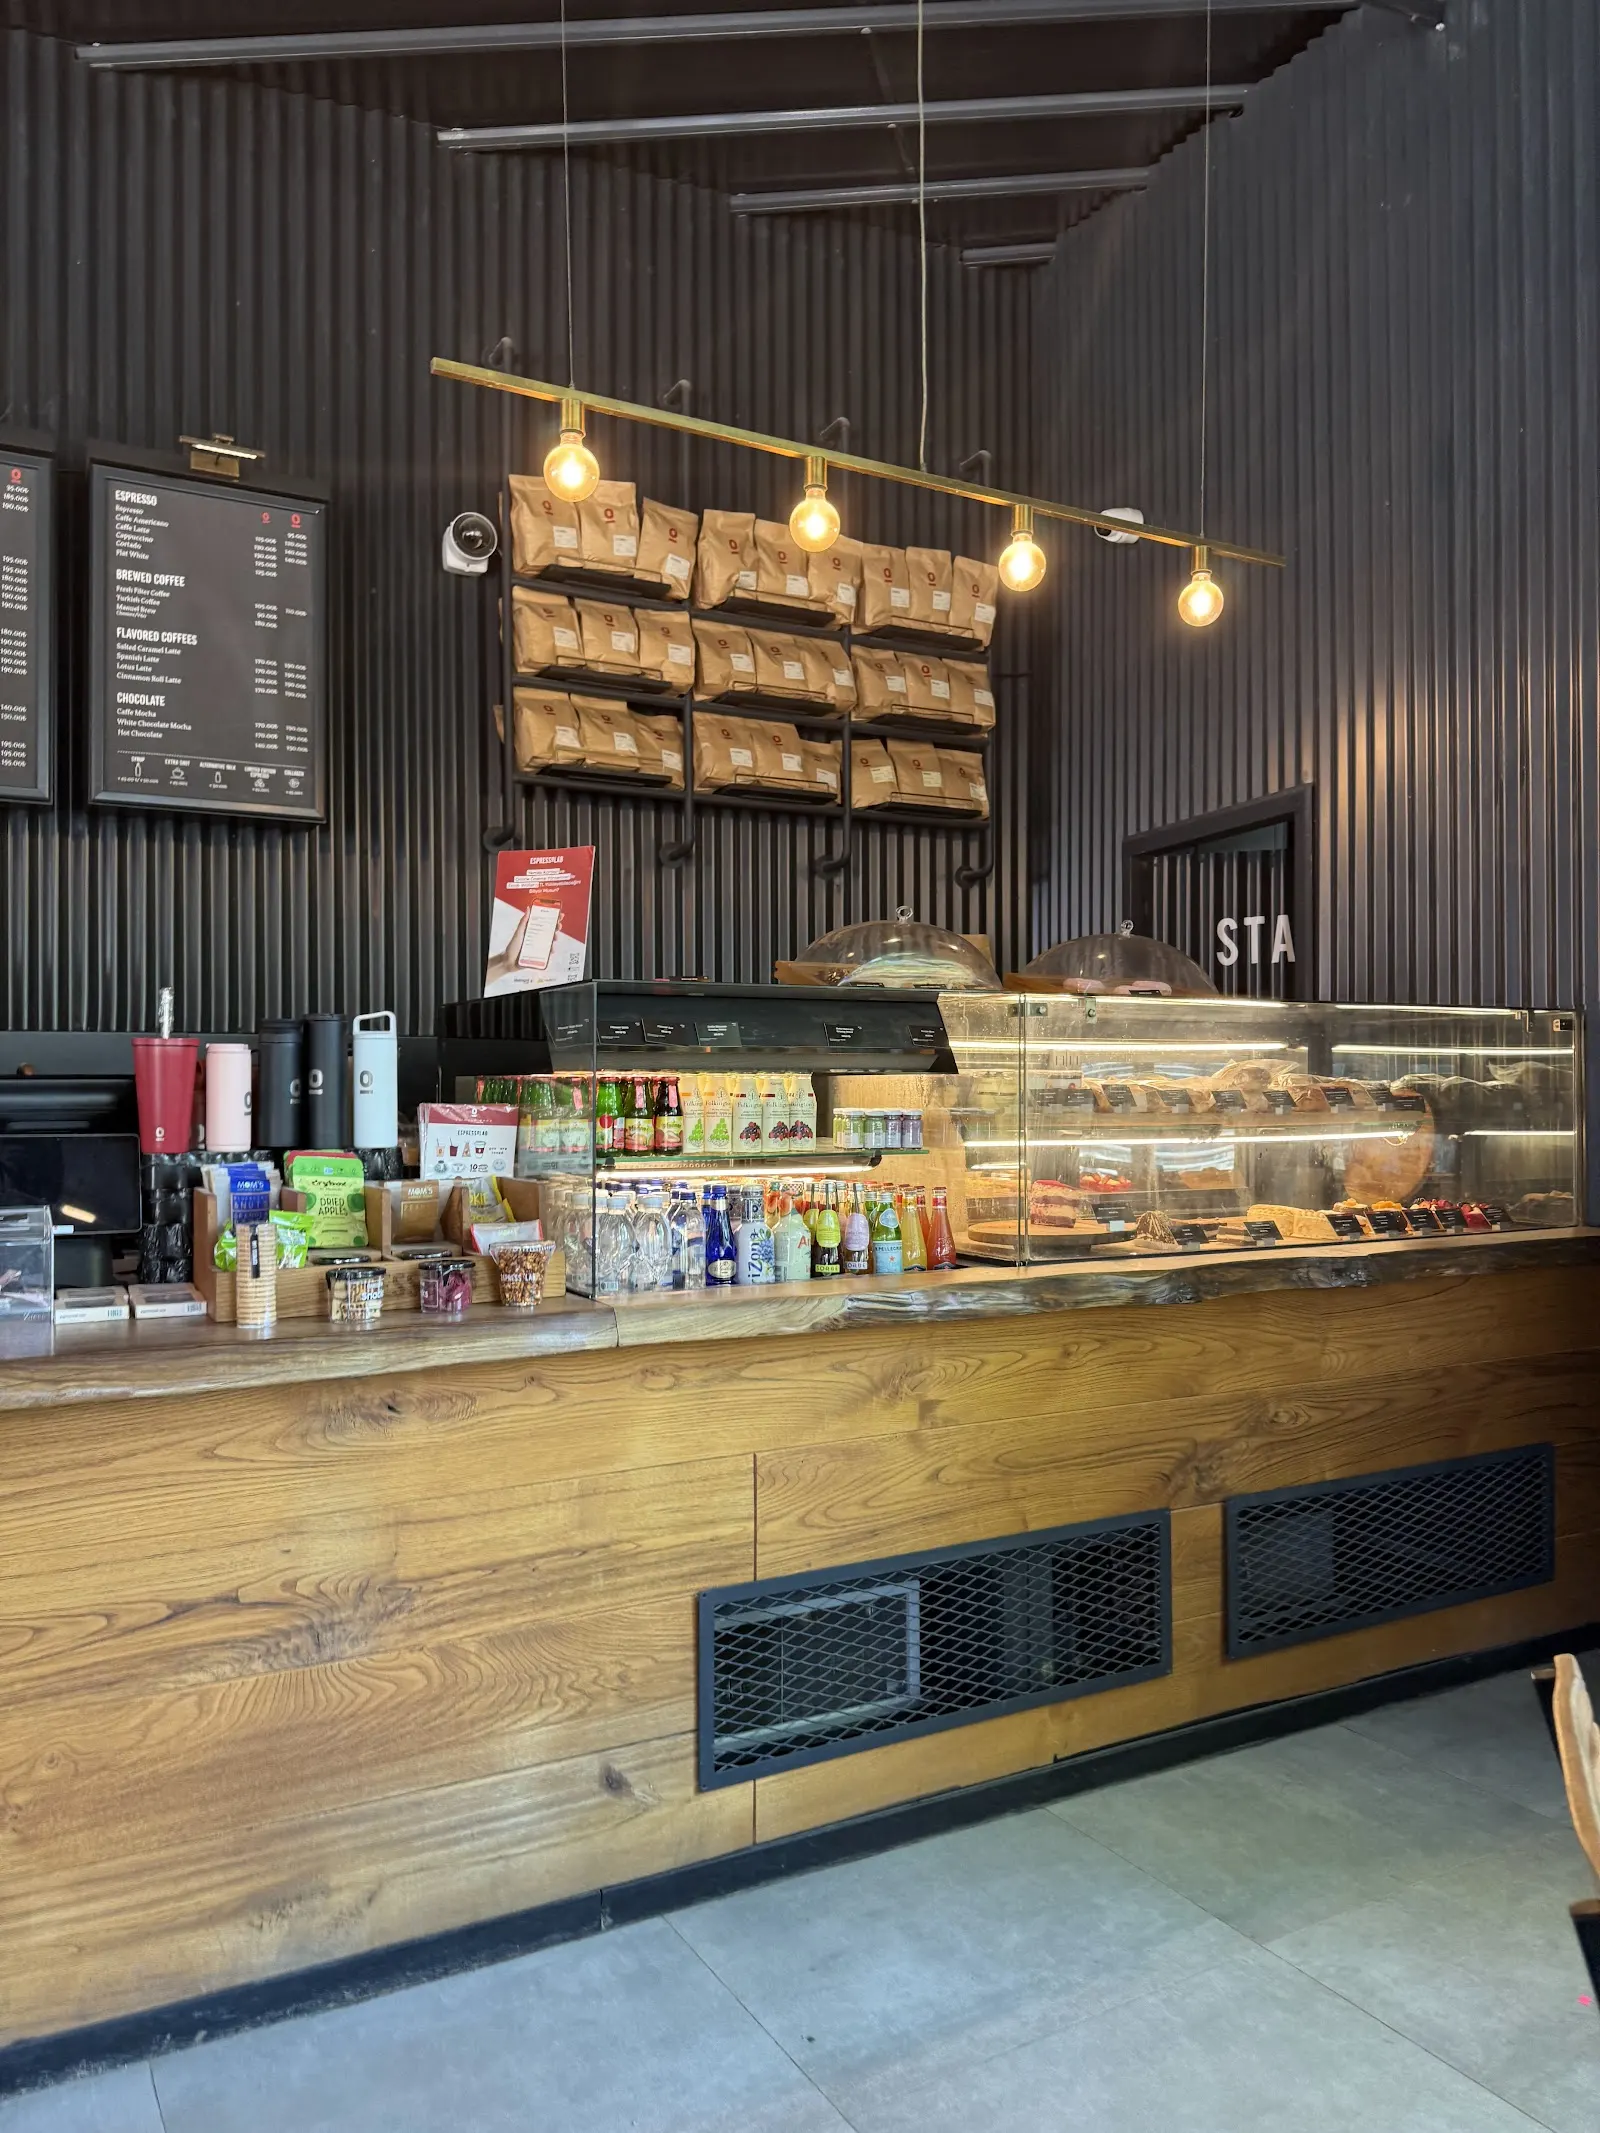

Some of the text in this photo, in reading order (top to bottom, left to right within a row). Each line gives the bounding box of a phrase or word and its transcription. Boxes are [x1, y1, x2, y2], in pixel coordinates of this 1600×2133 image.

[116, 490, 157, 506] ESPRESSO
[134, 517, 169, 527] Americano
[134, 525, 150, 534] Latte
[116, 532, 154, 543] Cappuccino
[116, 540, 141, 549] Cortado
[129, 550, 149, 560] White
[116, 569, 185, 587] BREWED COFFEE
[116, 585, 133, 593] Fresh
[134, 587, 150, 596] Filter
[116, 594, 160, 606] Turkish Coffee
[140, 606, 156, 614] Brew
[116, 627, 198, 645] FLAVORED COFFEES
[116, 643, 136, 651] Salted
[138, 645, 164, 654] Caramel
[116, 652, 160, 663] Spanish Latte
[117, 662, 134, 670] Lotus
[116, 672, 150, 682] Cinnamon
[116, 692, 165, 706] CHOCOLATE
[138, 720, 169, 728] Chocolate
[170, 722, 192, 730] Mocha
[131, 729, 162, 738] Chocolate
[1216, 914, 1295, 966] STA
[320, 1198, 344, 1206] DRIED
[318, 1206, 348, 1216] APPLES
